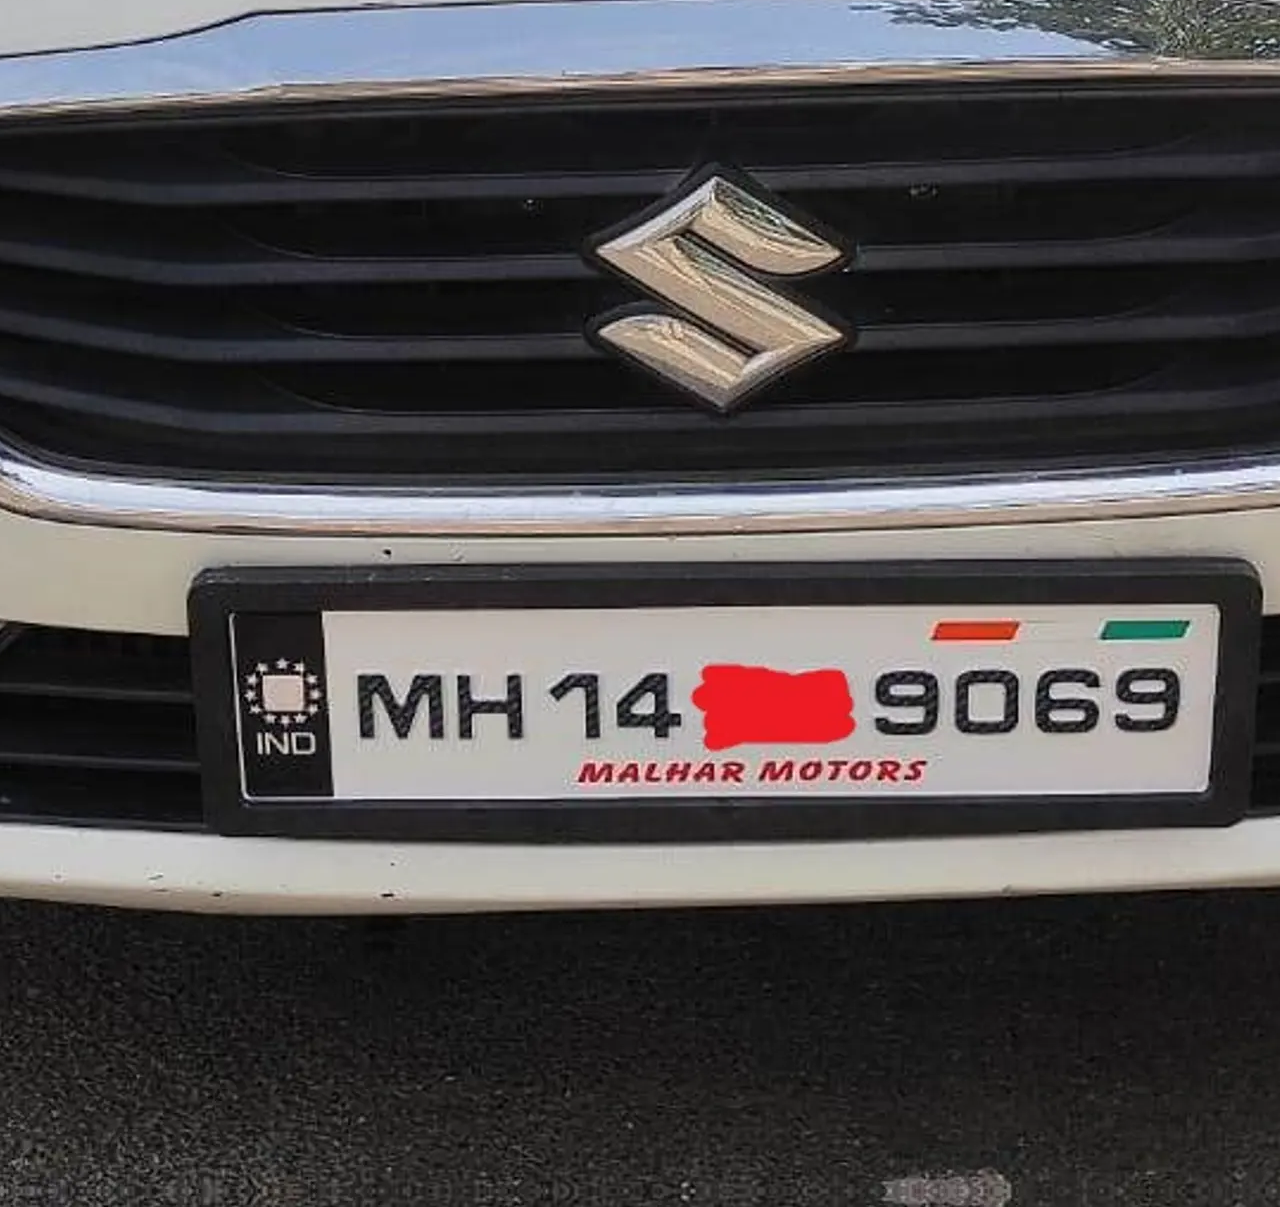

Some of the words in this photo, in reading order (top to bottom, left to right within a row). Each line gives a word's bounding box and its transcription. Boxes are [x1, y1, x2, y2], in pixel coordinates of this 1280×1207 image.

[355, 673, 526, 740] MH
[548, 672, 684, 740] 14
[872, 669, 1183, 736] 9069
[256, 731, 317, 756] IND
[577, 759, 746, 785] MALHAR
[757, 759, 928, 783] MOTORS
